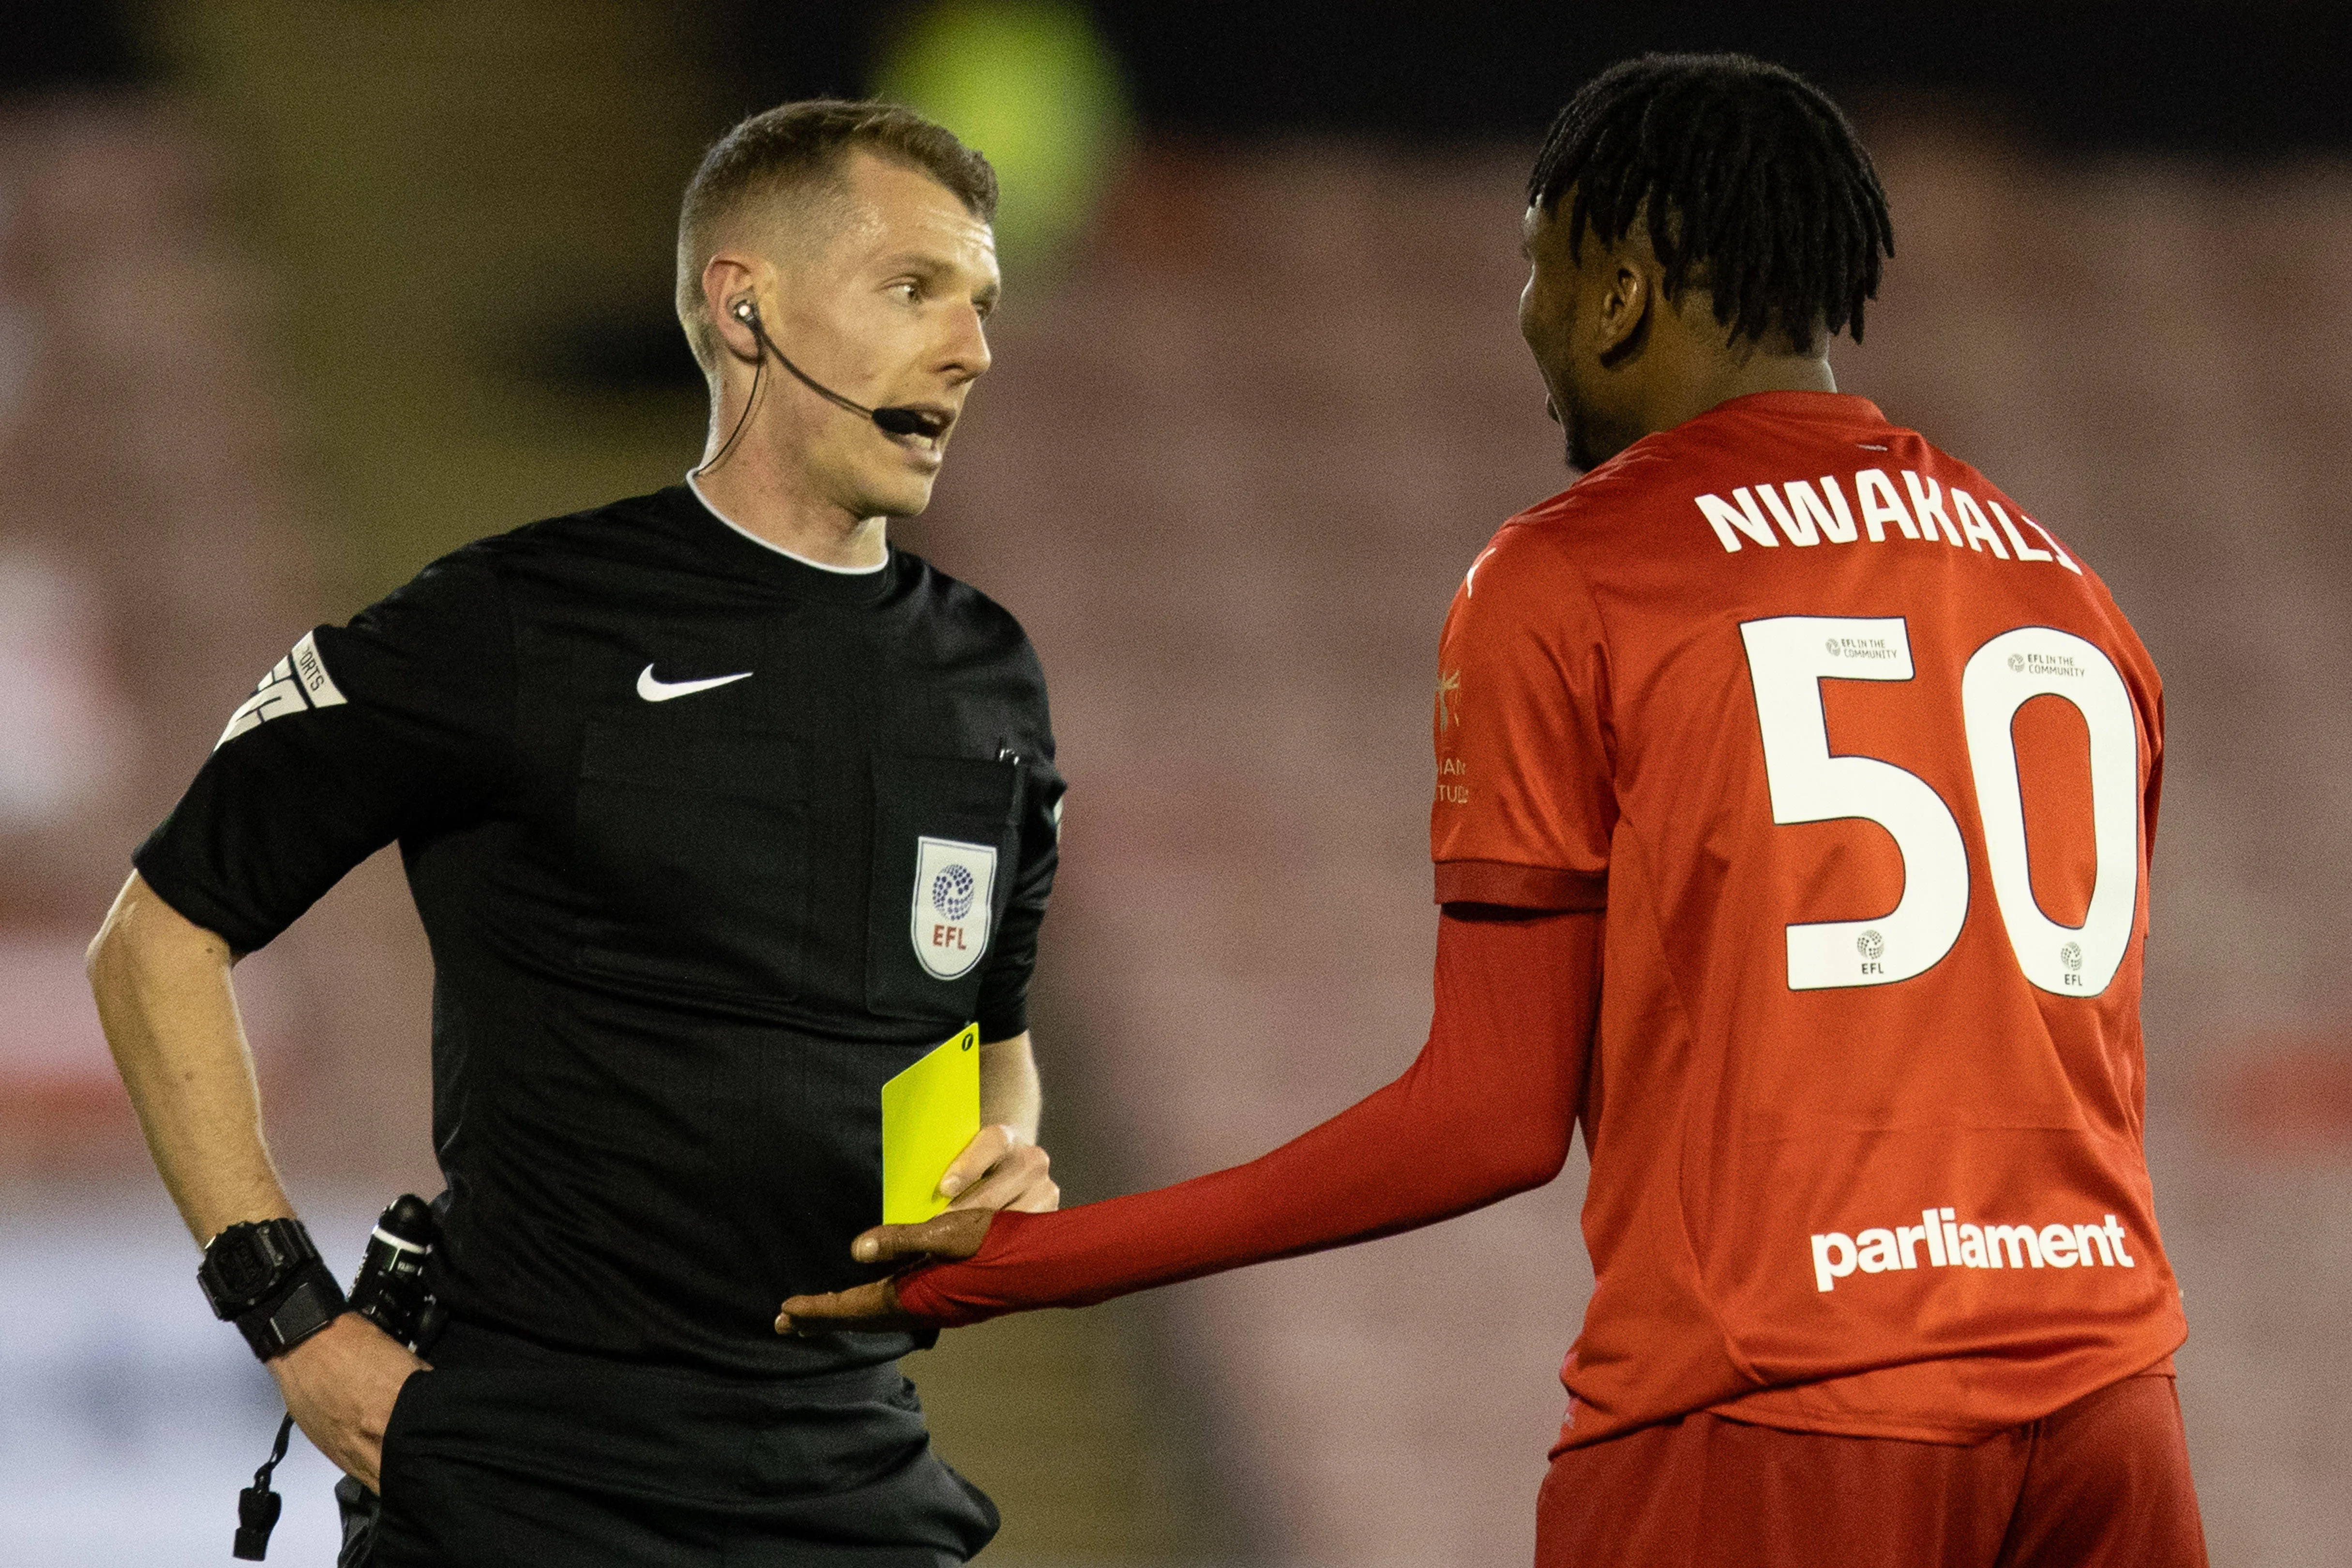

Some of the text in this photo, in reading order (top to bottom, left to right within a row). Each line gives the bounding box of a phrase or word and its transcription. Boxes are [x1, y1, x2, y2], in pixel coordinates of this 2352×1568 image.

[1841, 638, 1885, 648] EFL IN THE
[1844, 648, 1897, 659] COMMUNITY
[2027, 653, 2074, 666] EFL IN THE
[2029, 663, 2085, 677] COMMUNITY
[1740, 616, 2138, 997] 50
[933, 923, 967, 950] EFL
[1861, 963, 1884, 975] EFL
[2064, 974, 2082, 986] EFL
[1810, 1207, 2135, 1292] parliament
